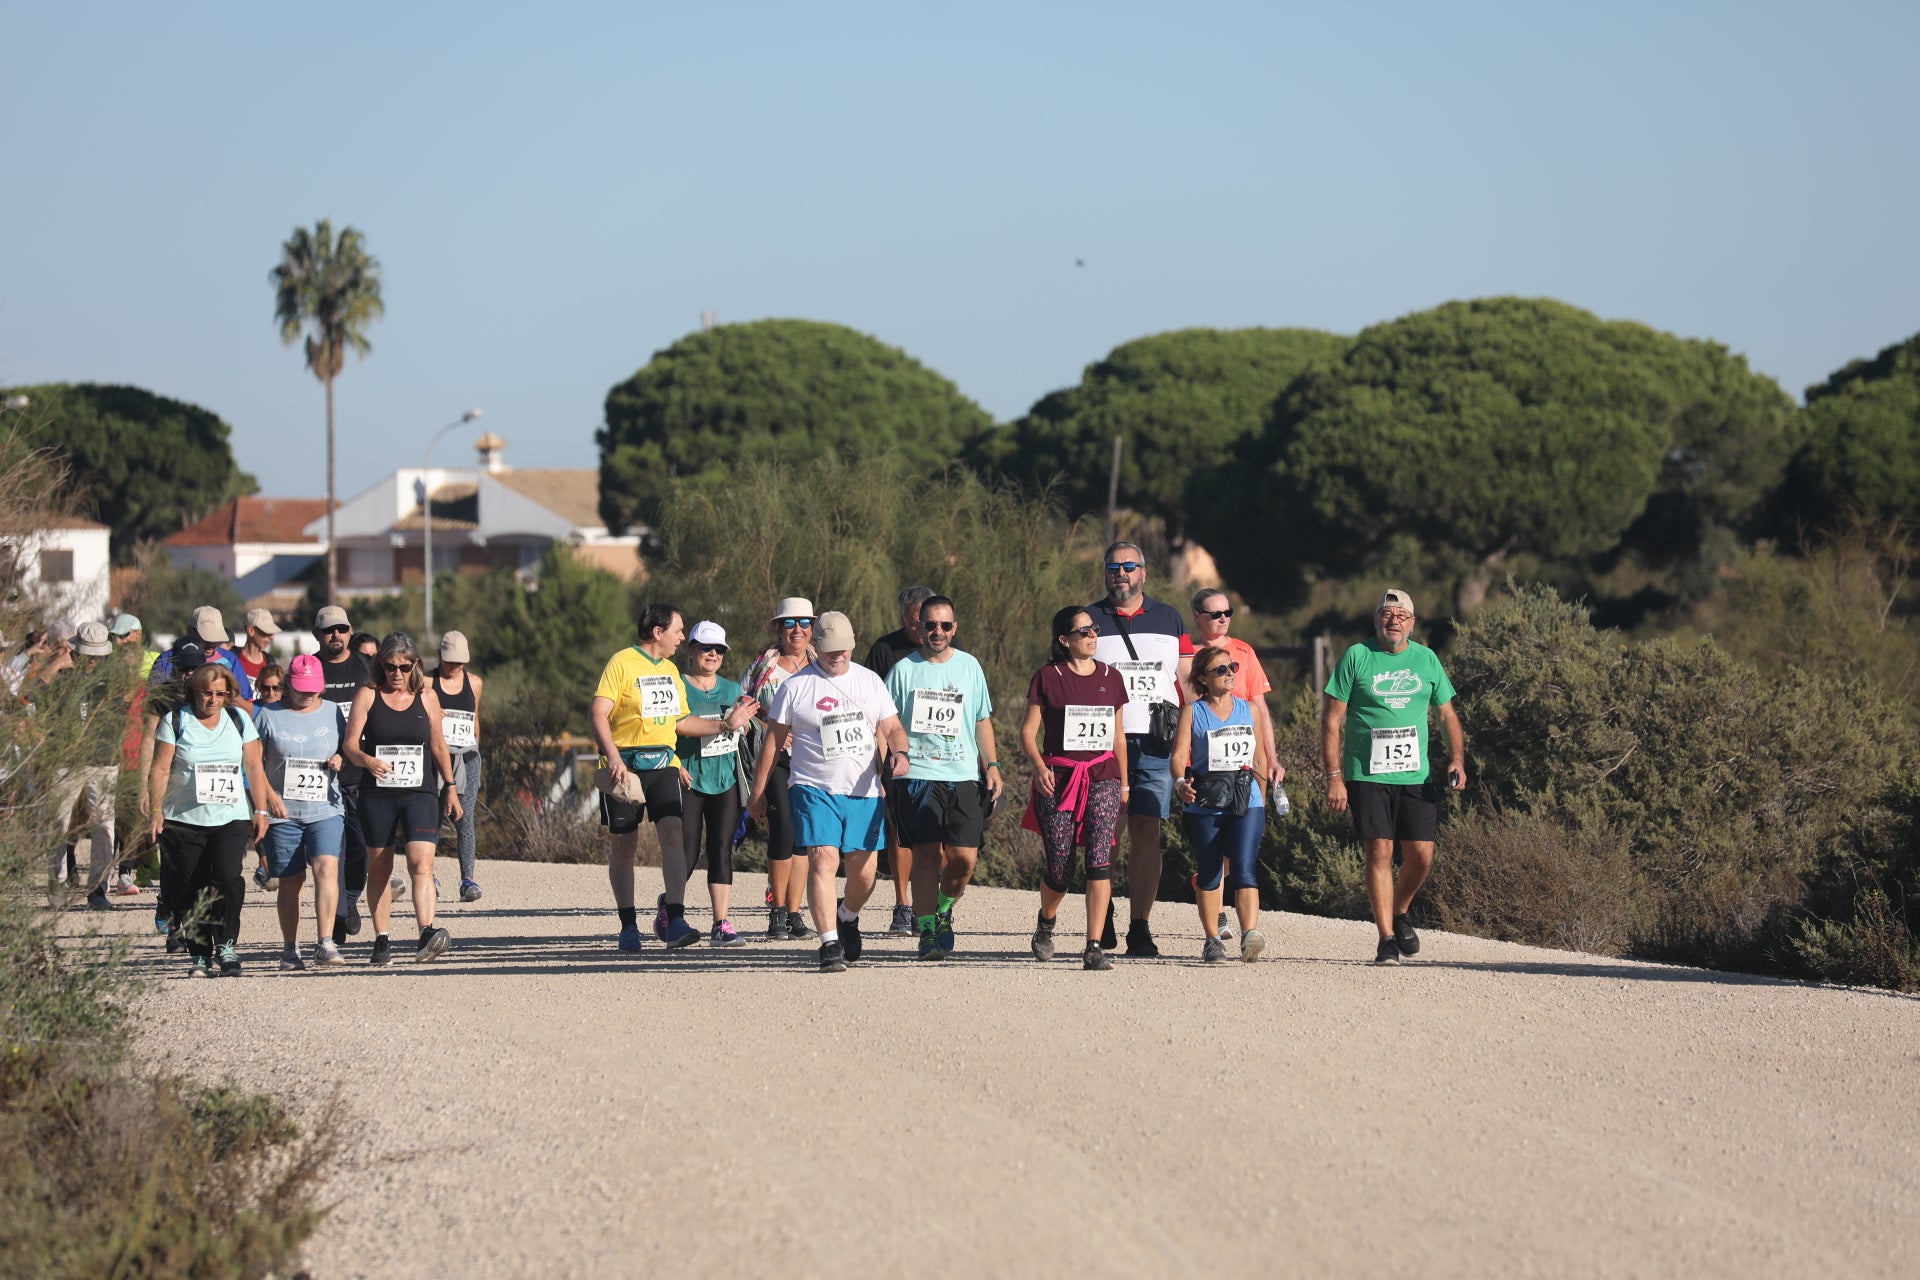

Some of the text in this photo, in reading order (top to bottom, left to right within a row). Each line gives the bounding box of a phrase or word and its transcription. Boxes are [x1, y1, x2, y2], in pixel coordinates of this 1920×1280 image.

[1129, 676, 1156, 690] 153
[652, 690, 673, 704] 229
[928, 706, 955, 722] 169
[452, 724, 471, 736] 159
[836, 727, 863, 744] 168
[1078, 722, 1107, 737] 213
[1224, 741, 1249, 757] 192
[1384, 744, 1412, 759] 152
[390, 761, 416, 774] 173
[210, 778, 235, 792] 174
[297, 775, 323, 789] 222
